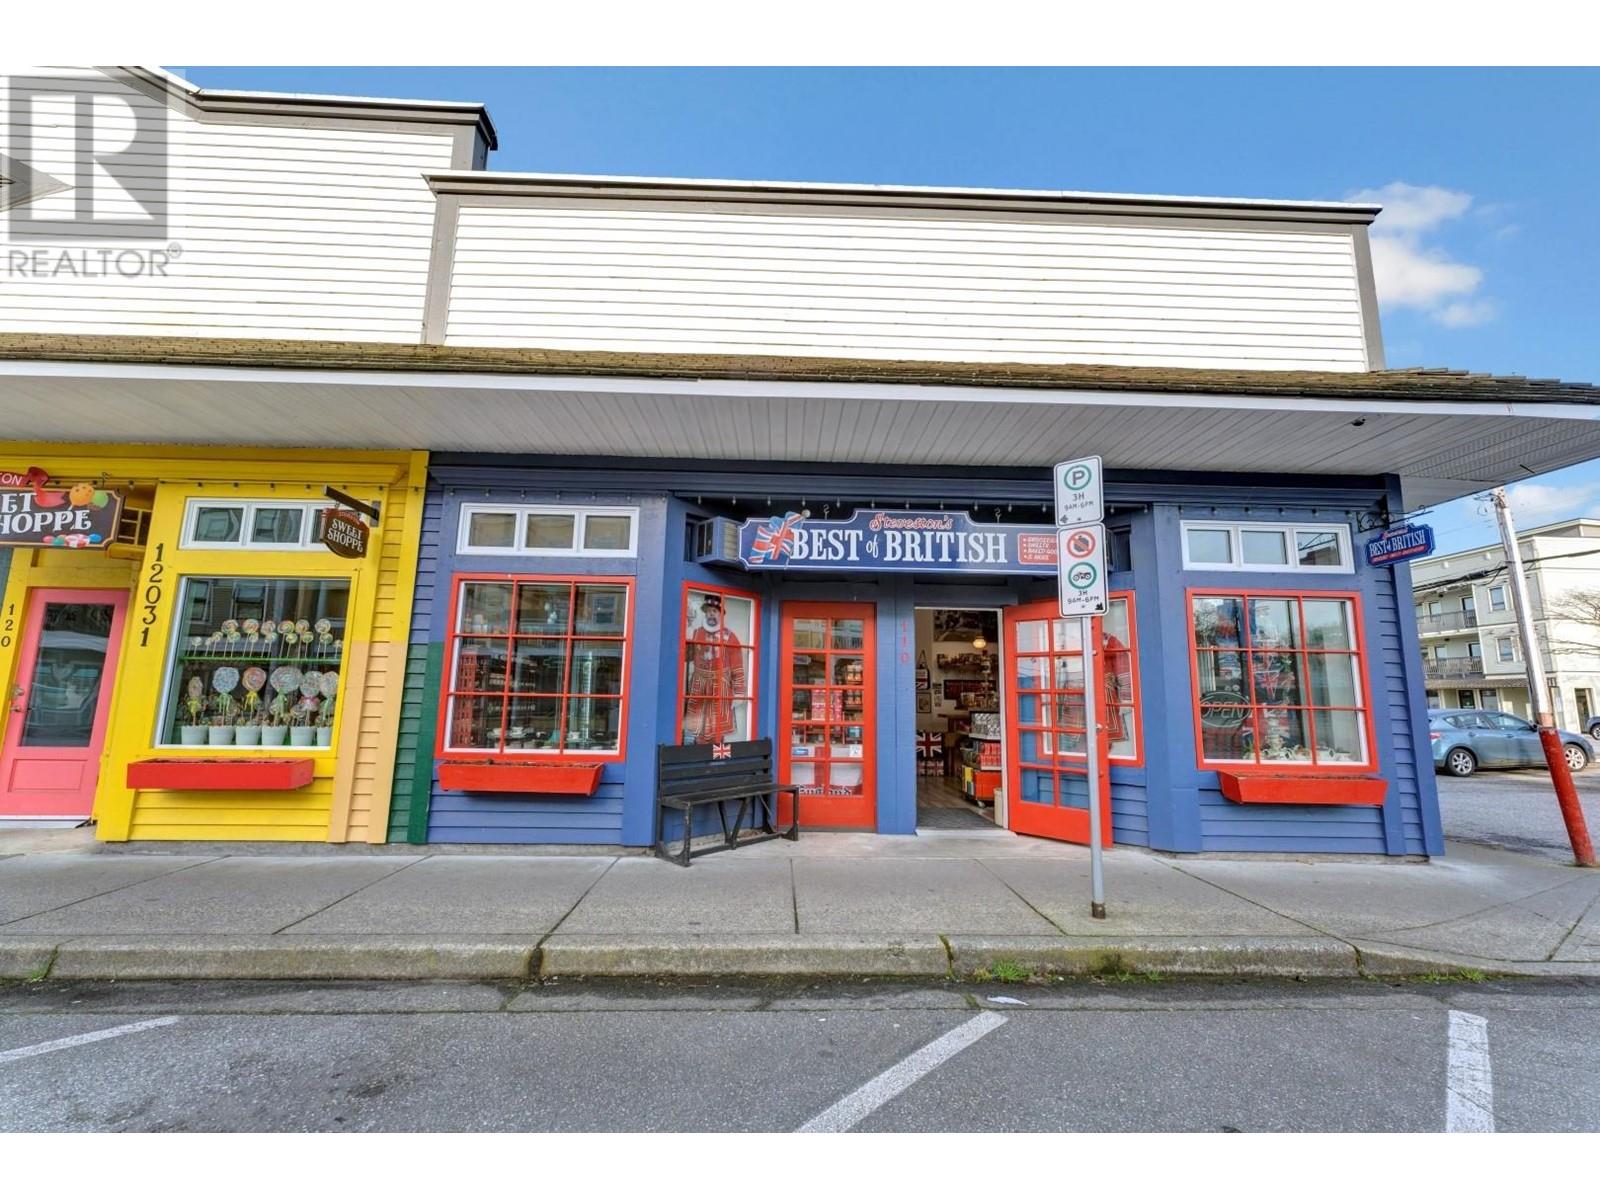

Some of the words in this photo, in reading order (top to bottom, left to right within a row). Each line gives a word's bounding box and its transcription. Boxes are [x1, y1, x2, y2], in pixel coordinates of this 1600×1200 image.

[331, 518, 363, 540] SWEET
[869, 512, 954, 531] Steveston's
[327, 528, 364, 553] SHOPPE
[790, 528, 863, 560] BEST
[866, 534, 879, 558] of
[884, 531, 1008, 563] BRITISH
[1368, 540, 1387, 557] BEST
[1391, 529, 1426, 551] BRITISH
[140, 543, 163, 647] 12031
[1202, 701, 1244, 718] OPEN
